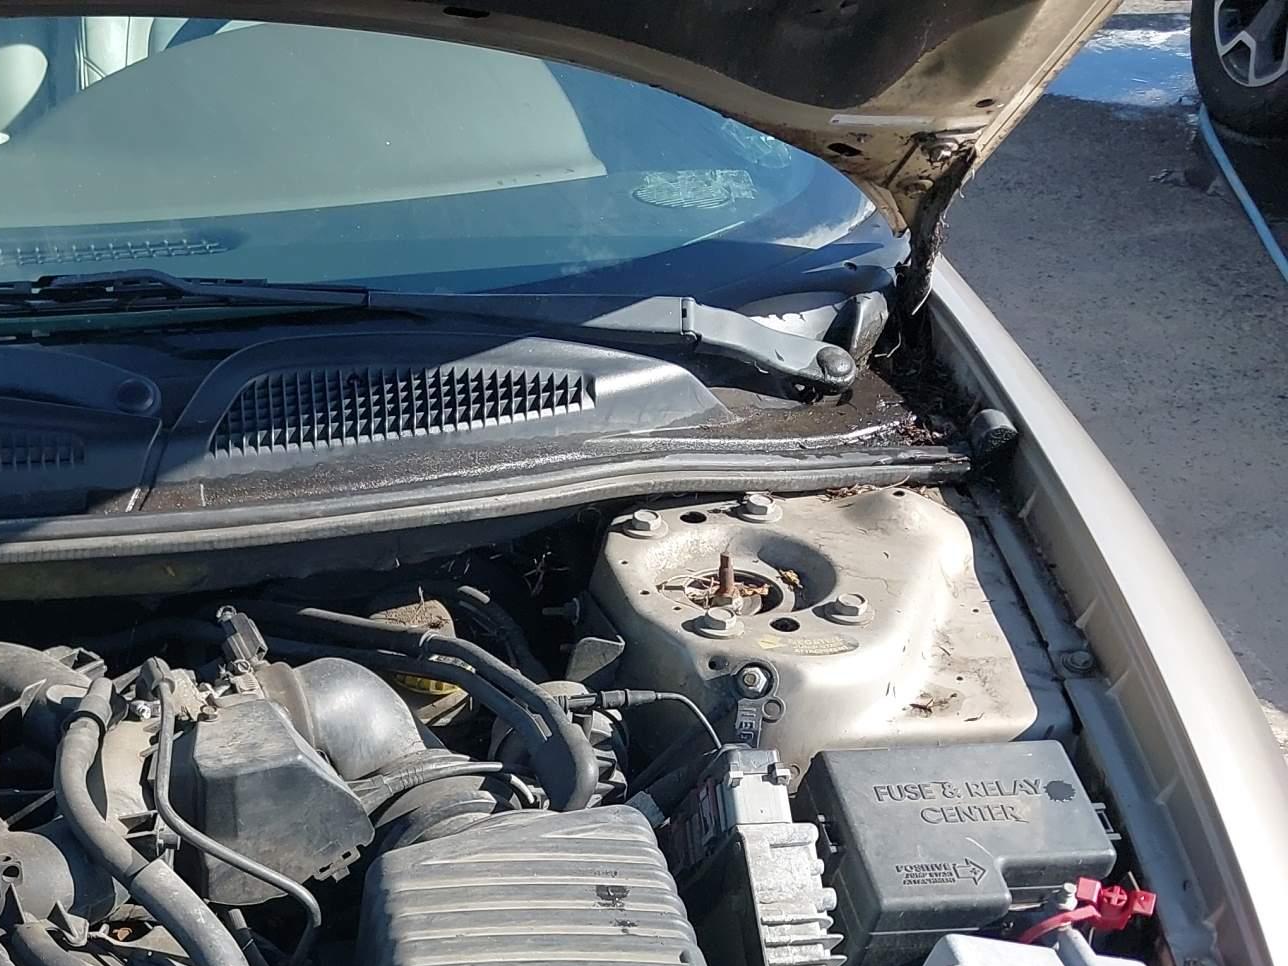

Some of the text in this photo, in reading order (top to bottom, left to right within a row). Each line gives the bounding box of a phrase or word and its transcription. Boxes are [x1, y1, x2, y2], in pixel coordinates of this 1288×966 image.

[873, 778, 1041, 802] FUSE & RELAY
[920, 804, 1030, 824] CENTER
